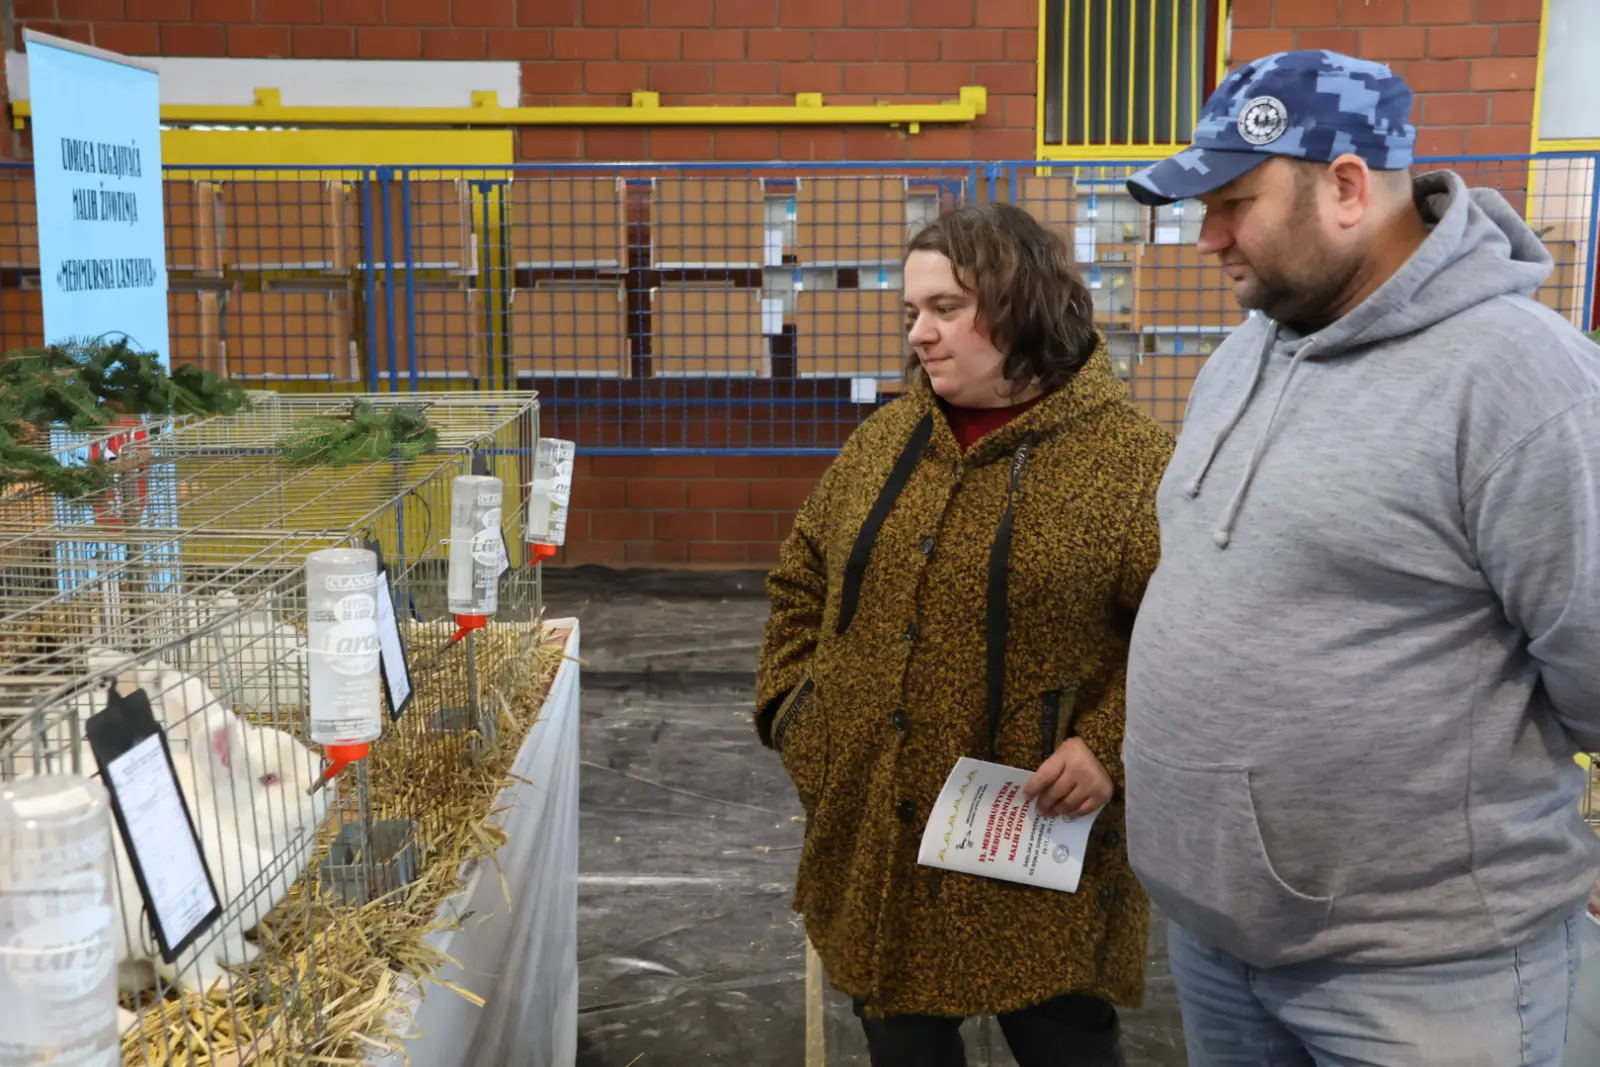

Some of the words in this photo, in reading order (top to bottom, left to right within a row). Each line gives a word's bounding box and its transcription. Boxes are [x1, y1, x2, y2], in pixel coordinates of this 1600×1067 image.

[61, 137, 96, 173] UDRUGA
[72, 187, 98, 220] MALIH
[1007, 833, 1021, 862] MALIH
